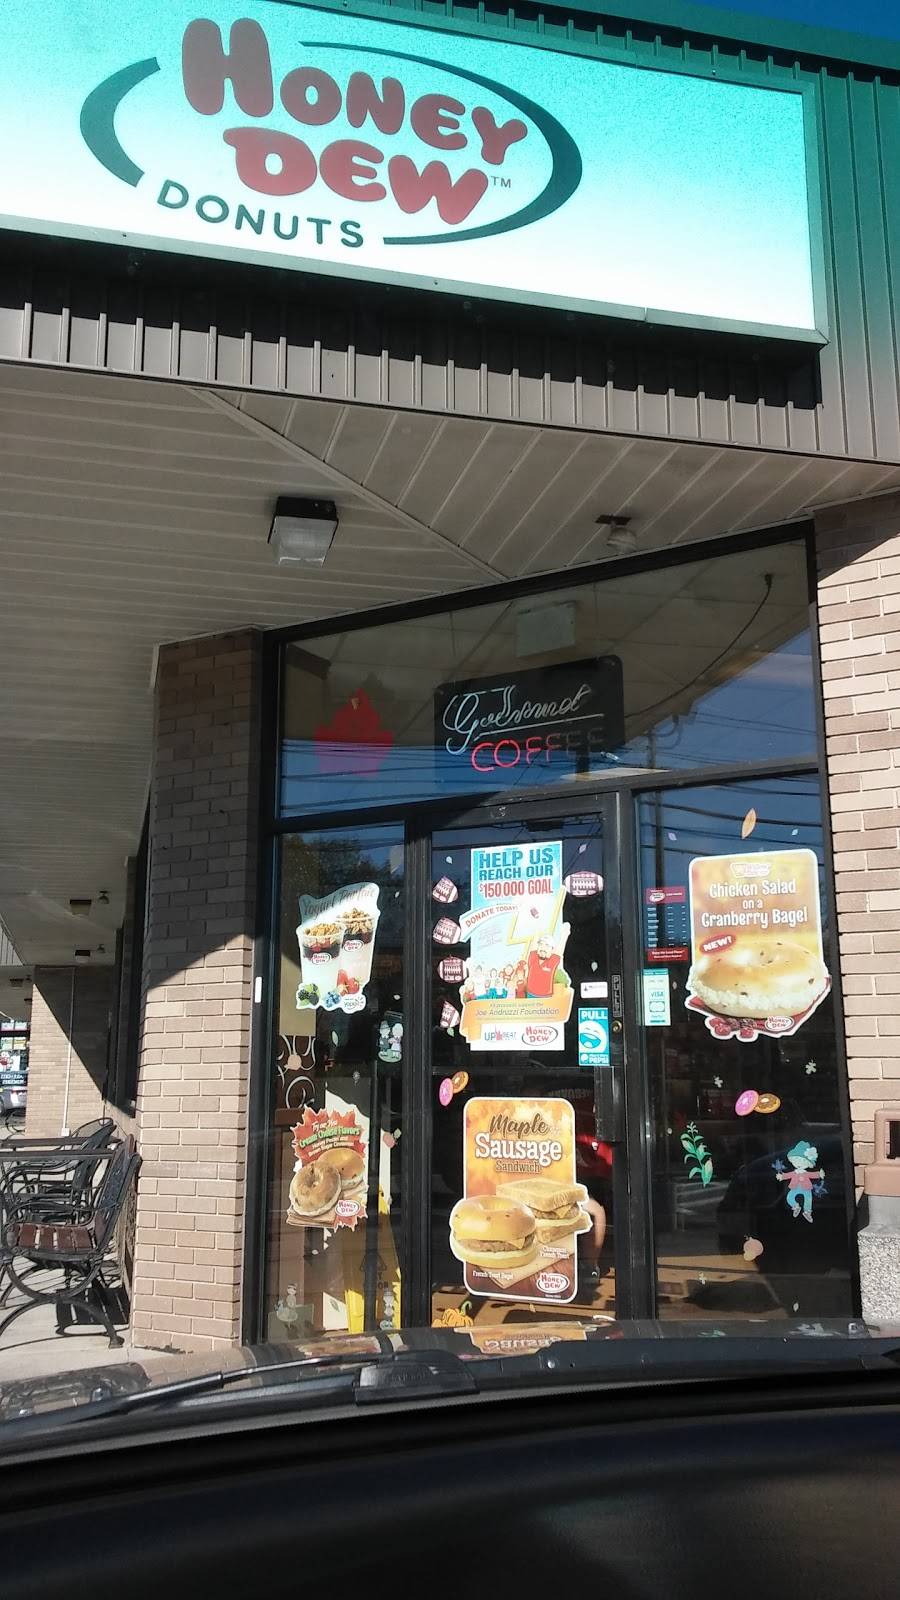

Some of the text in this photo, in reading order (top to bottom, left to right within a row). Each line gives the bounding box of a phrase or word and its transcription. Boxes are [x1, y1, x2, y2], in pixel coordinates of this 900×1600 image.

[182, 18, 528, 165] HONEY
[223, 126, 489, 225] DEW
[157, 179, 364, 248] DONUTS
[471, 727, 605, 772] COFFEE
[479, 847, 554, 869] HELP US
[479, 864, 554, 881] REACH OUR
[528, 878, 554, 893] GOAL
[709, 879, 796, 898] Chicken Salad
[742, 898, 763, 910] on a
[465, 908, 495, 928] DONATE
[701, 911, 768, 928] Cranberry
[772, 906, 808, 928] Bagel
[703, 935, 733, 952] NEW!
[520, 1007, 560, 1015] Foundation
[581, 1010, 608, 1020] PULL
[489, 1113, 550, 1139] Maple
[475, 1132, 563, 1166] Sausage
[495, 1159, 540, 1173] Sandwich
[541, 1274, 565, 1284] HONEY
